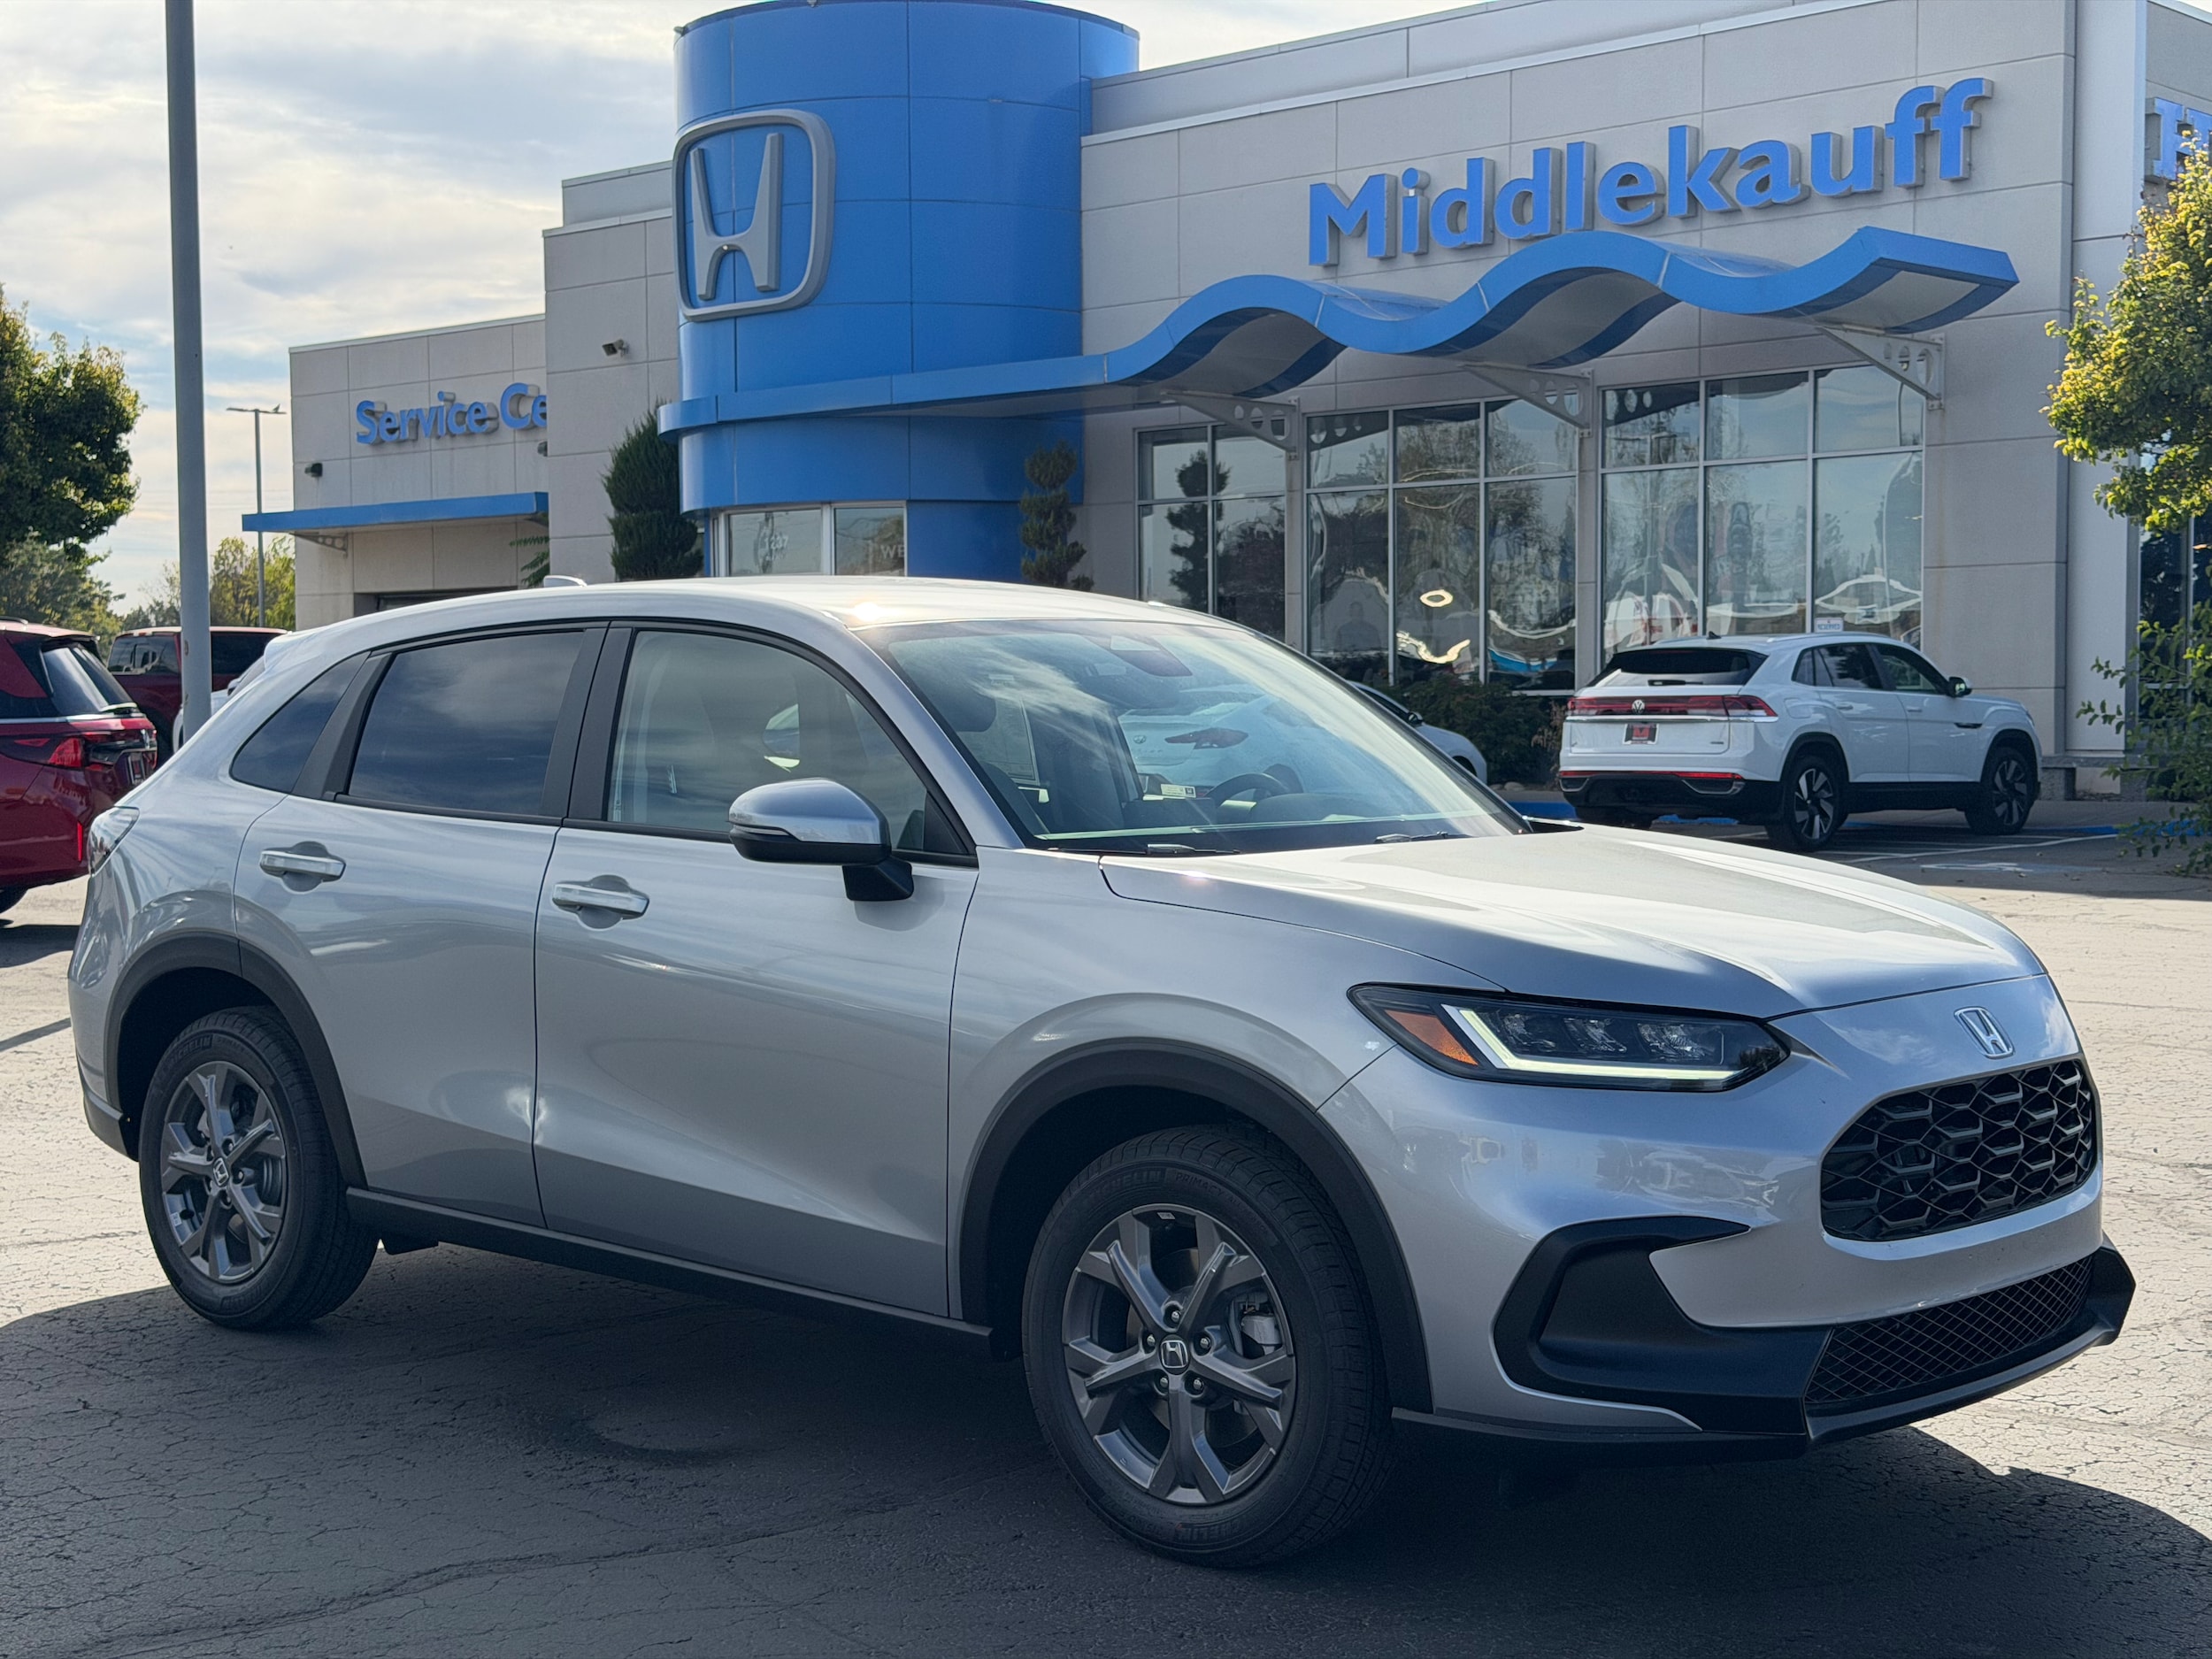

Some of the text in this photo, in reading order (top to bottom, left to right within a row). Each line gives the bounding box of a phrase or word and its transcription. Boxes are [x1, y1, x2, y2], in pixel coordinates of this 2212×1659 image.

[1310, 77, 1993, 266] Middlekauff
[357, 382, 547, 444] Service Ce
